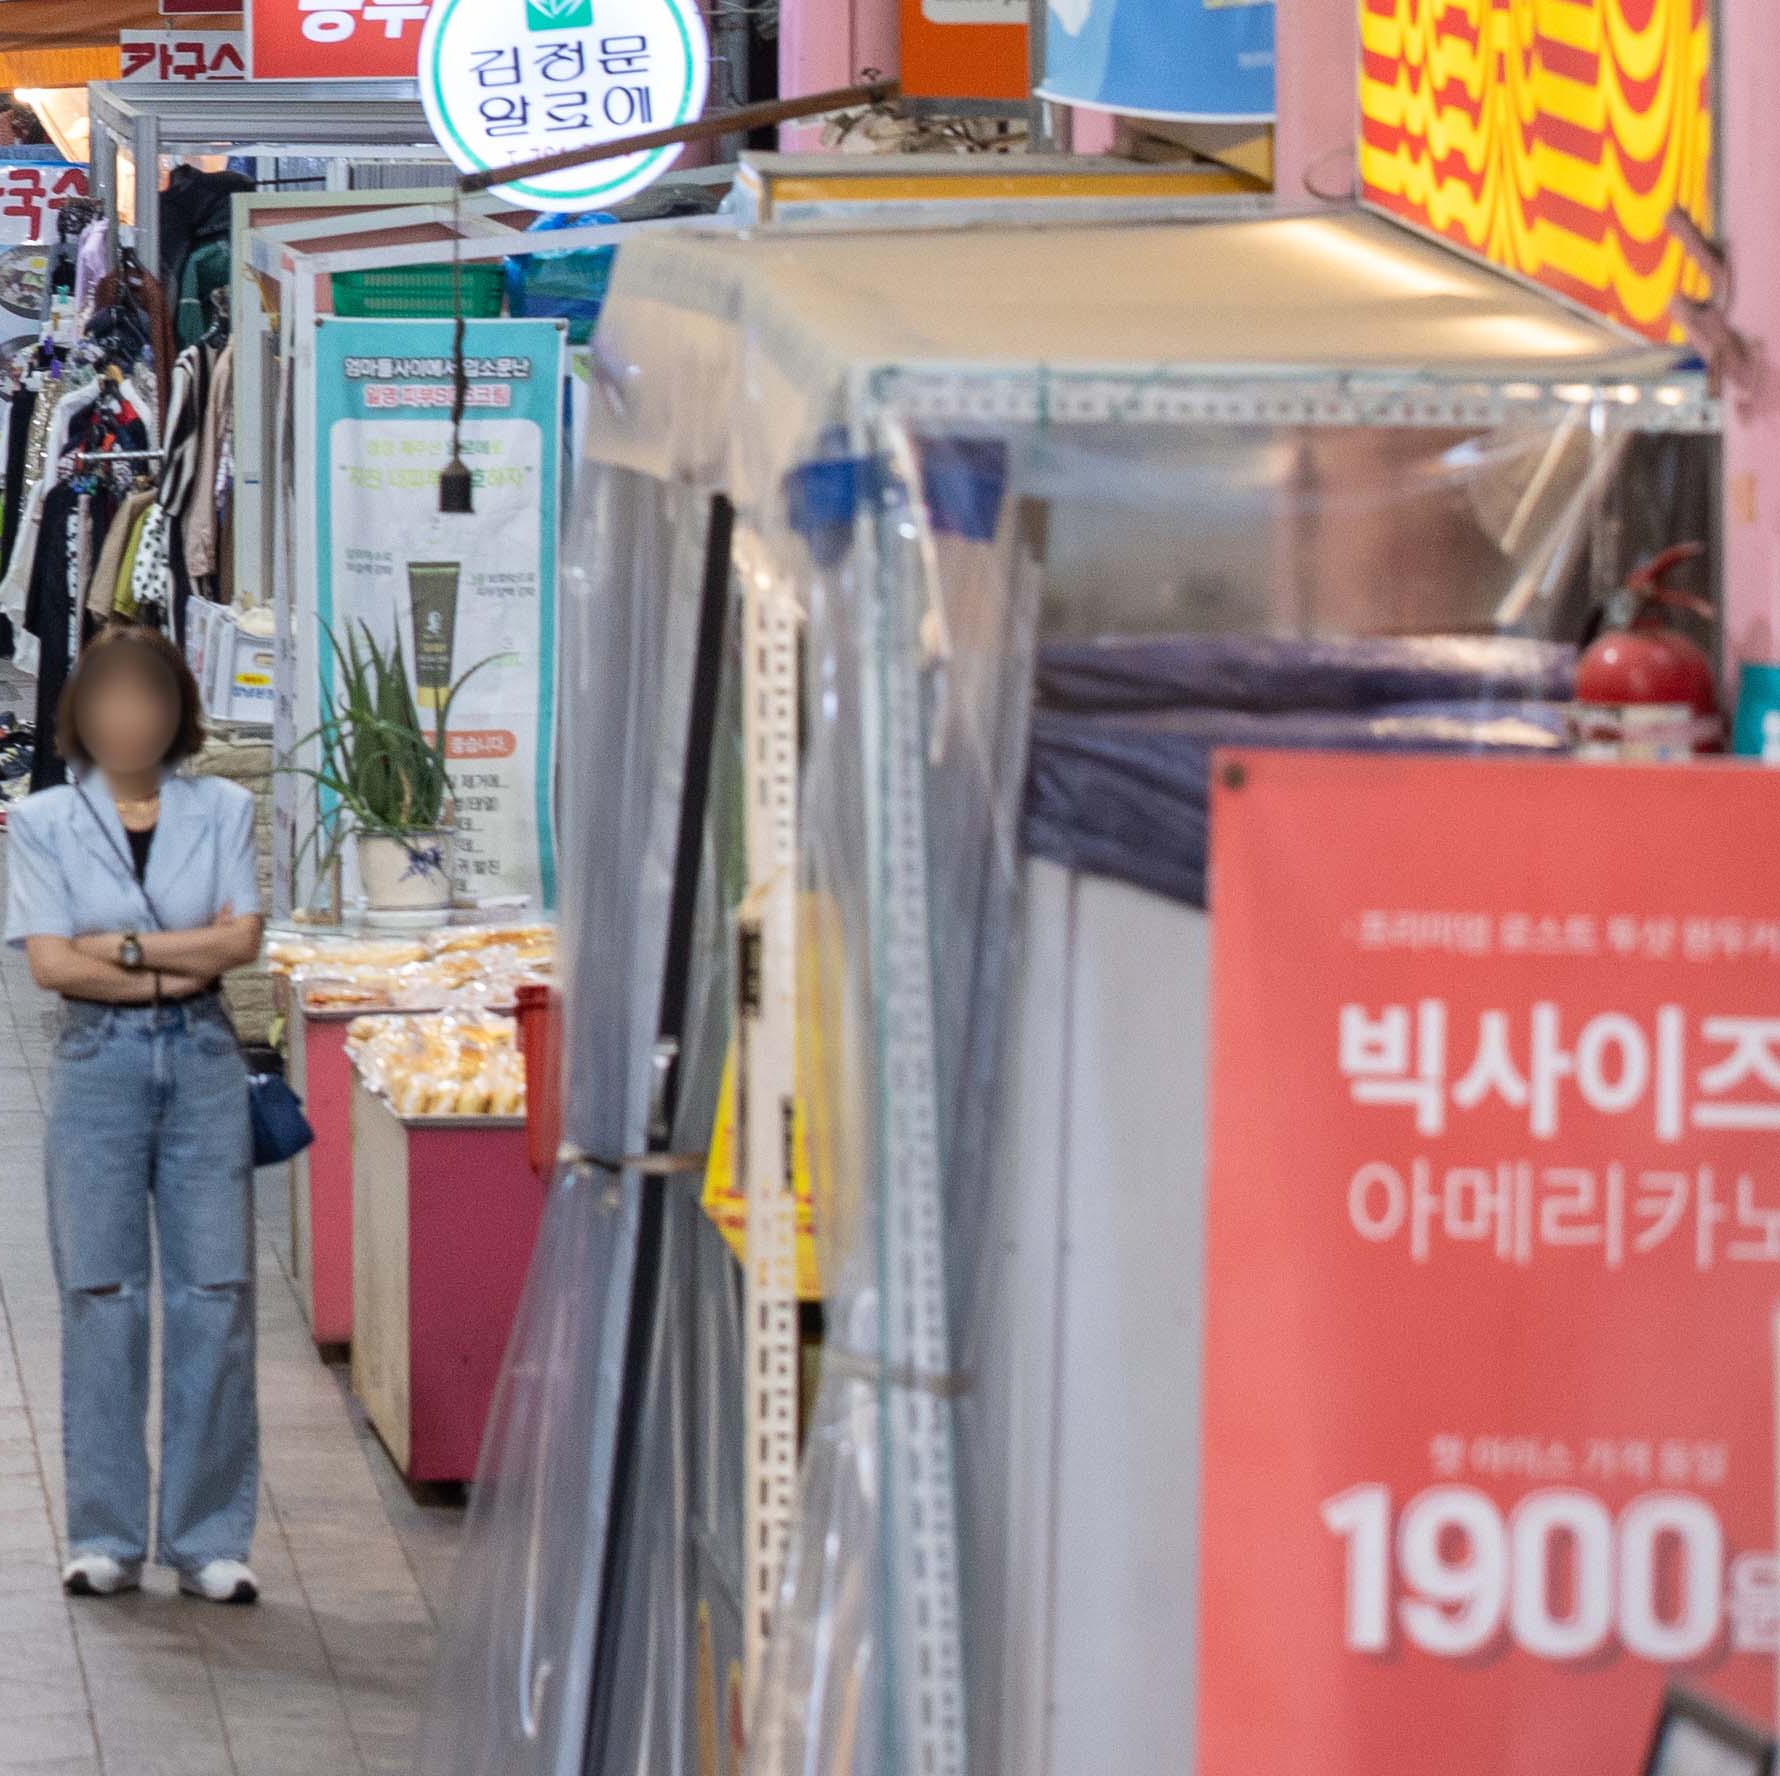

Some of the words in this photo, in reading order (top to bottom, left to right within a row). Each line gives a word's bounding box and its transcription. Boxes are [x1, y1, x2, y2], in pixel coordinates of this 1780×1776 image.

[469, 34, 652, 90] 김정문
[1338, 998, 1780, 1142] 빅사이즈
[1346, 1154, 1780, 1270] 아메리카노
